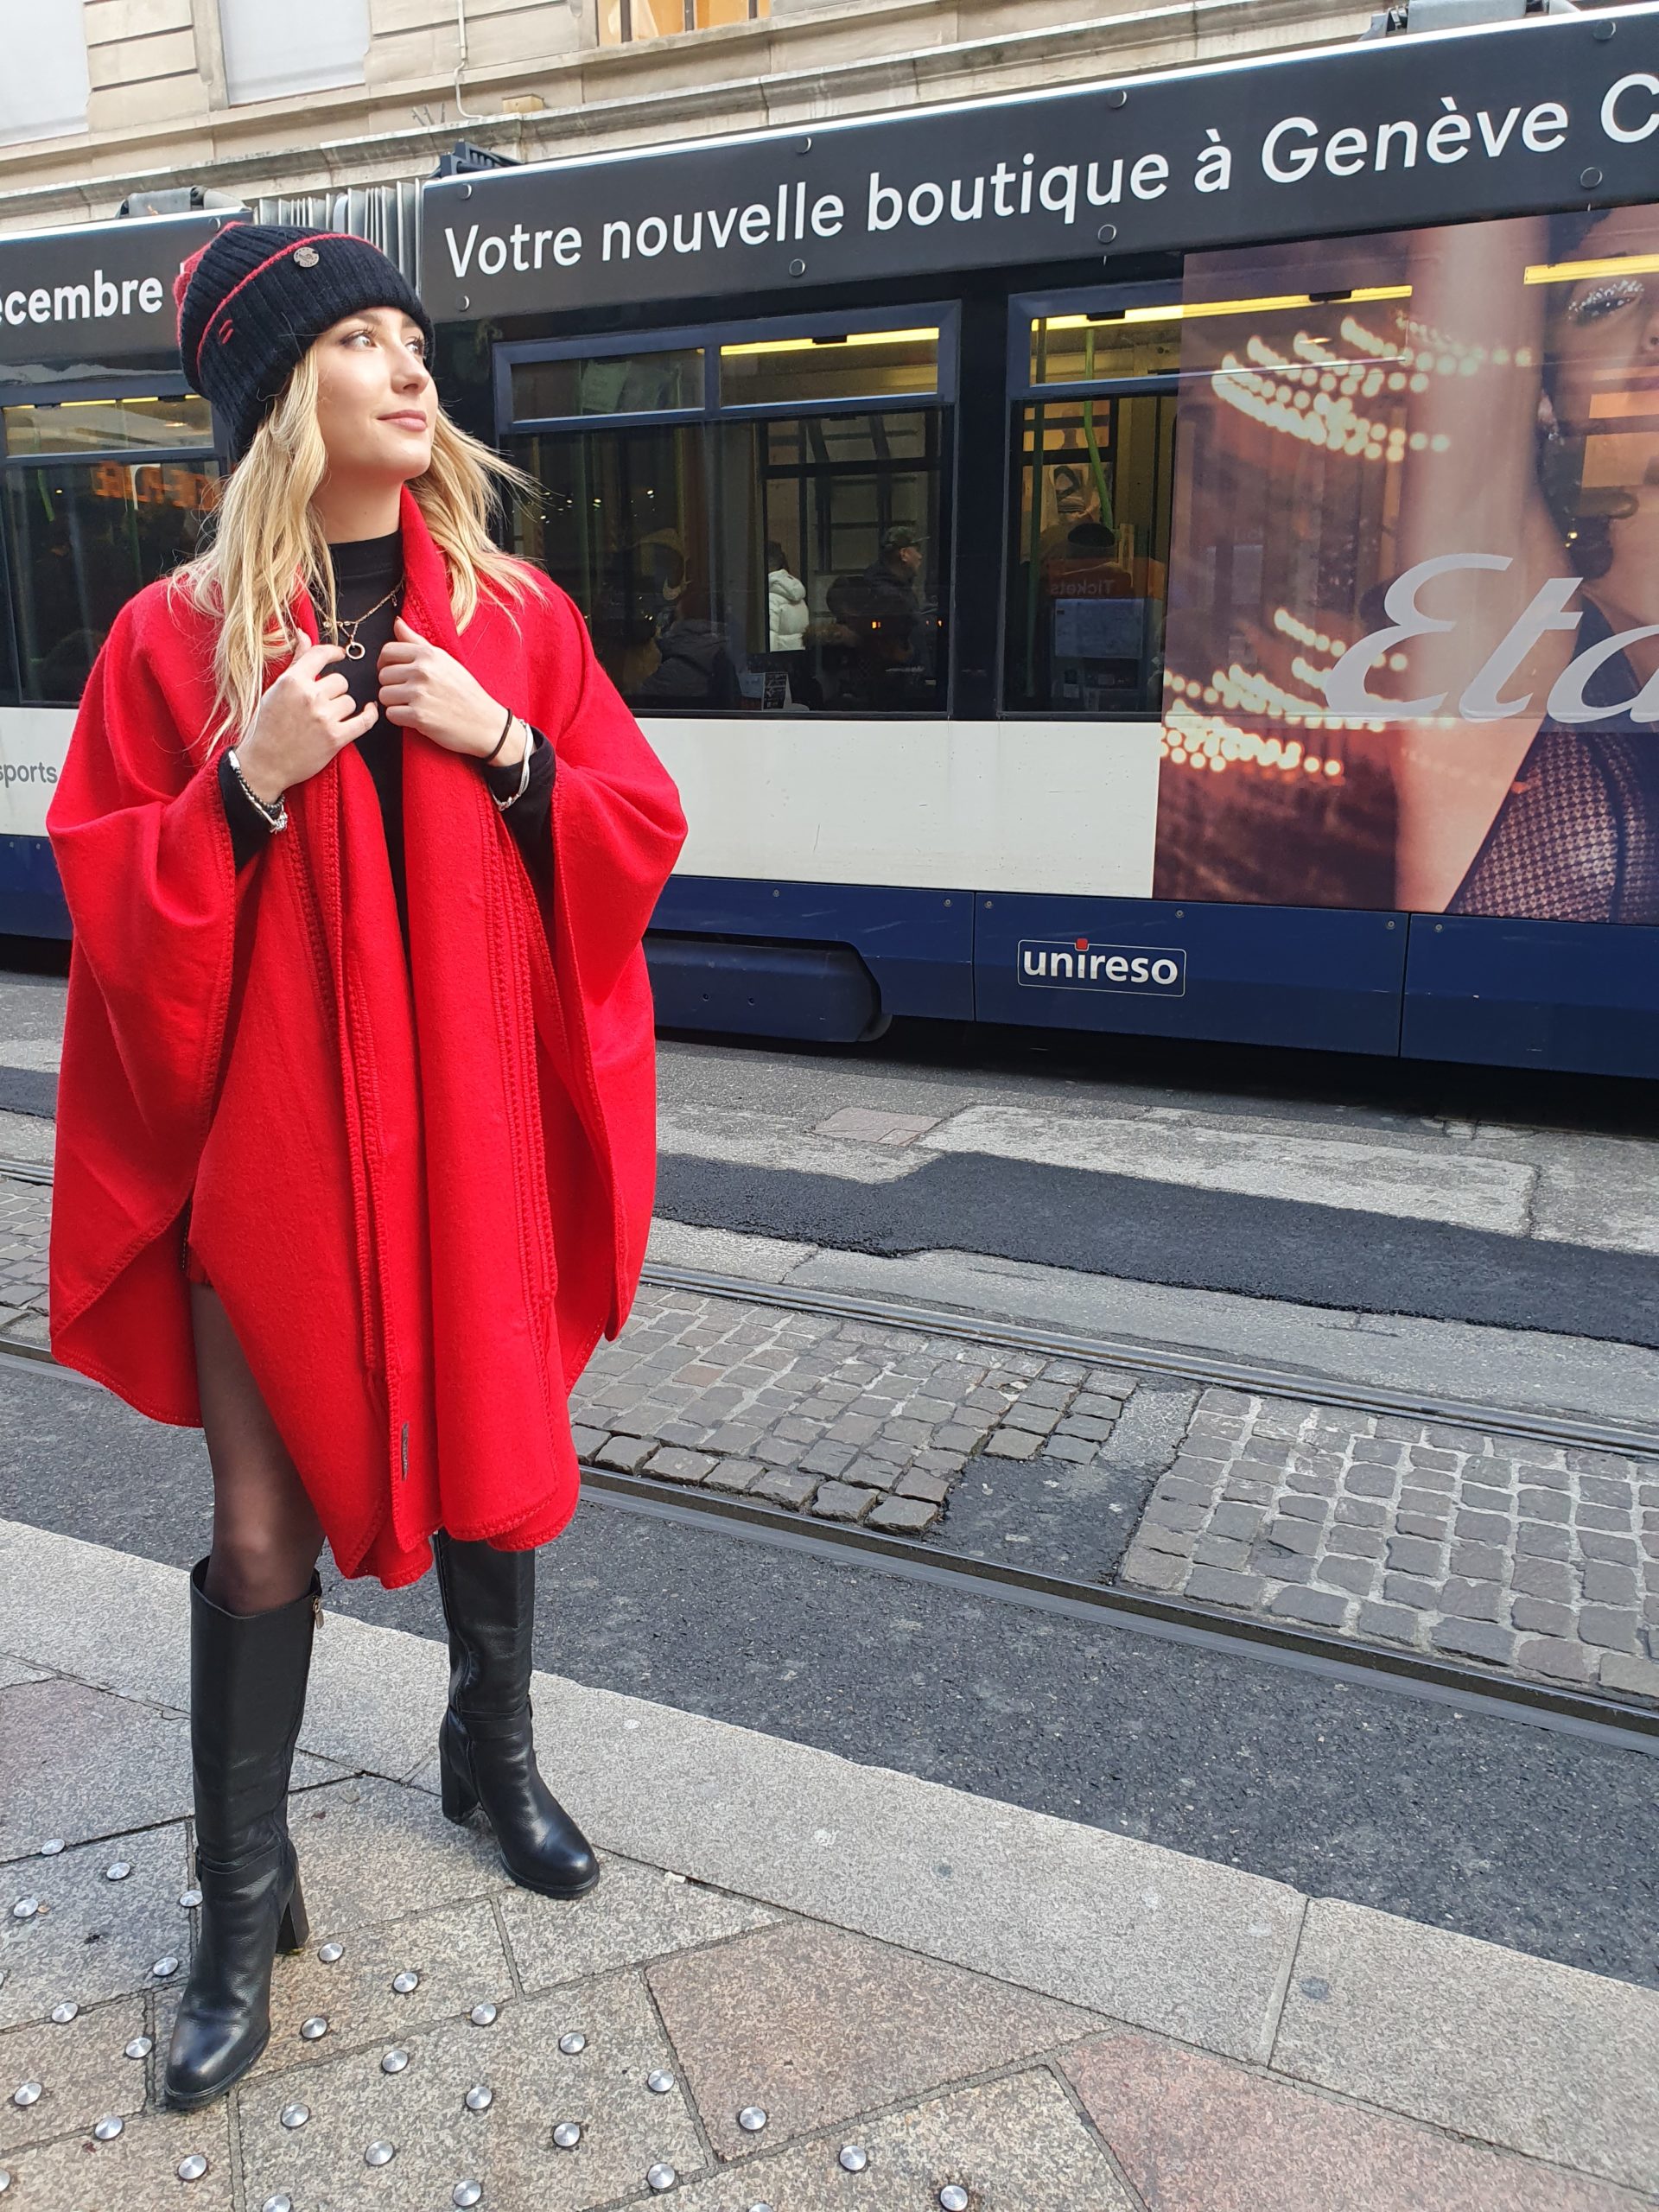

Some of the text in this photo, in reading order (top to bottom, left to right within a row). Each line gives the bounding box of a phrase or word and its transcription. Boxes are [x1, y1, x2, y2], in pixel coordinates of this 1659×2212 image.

[444, 73, 1659, 278] Votre nouvelle boutique à Genève C
[0, 269, 164, 326] cembre
[1325, 552, 1659, 723] Eta
[1023, 938, 1179, 985] unireso
